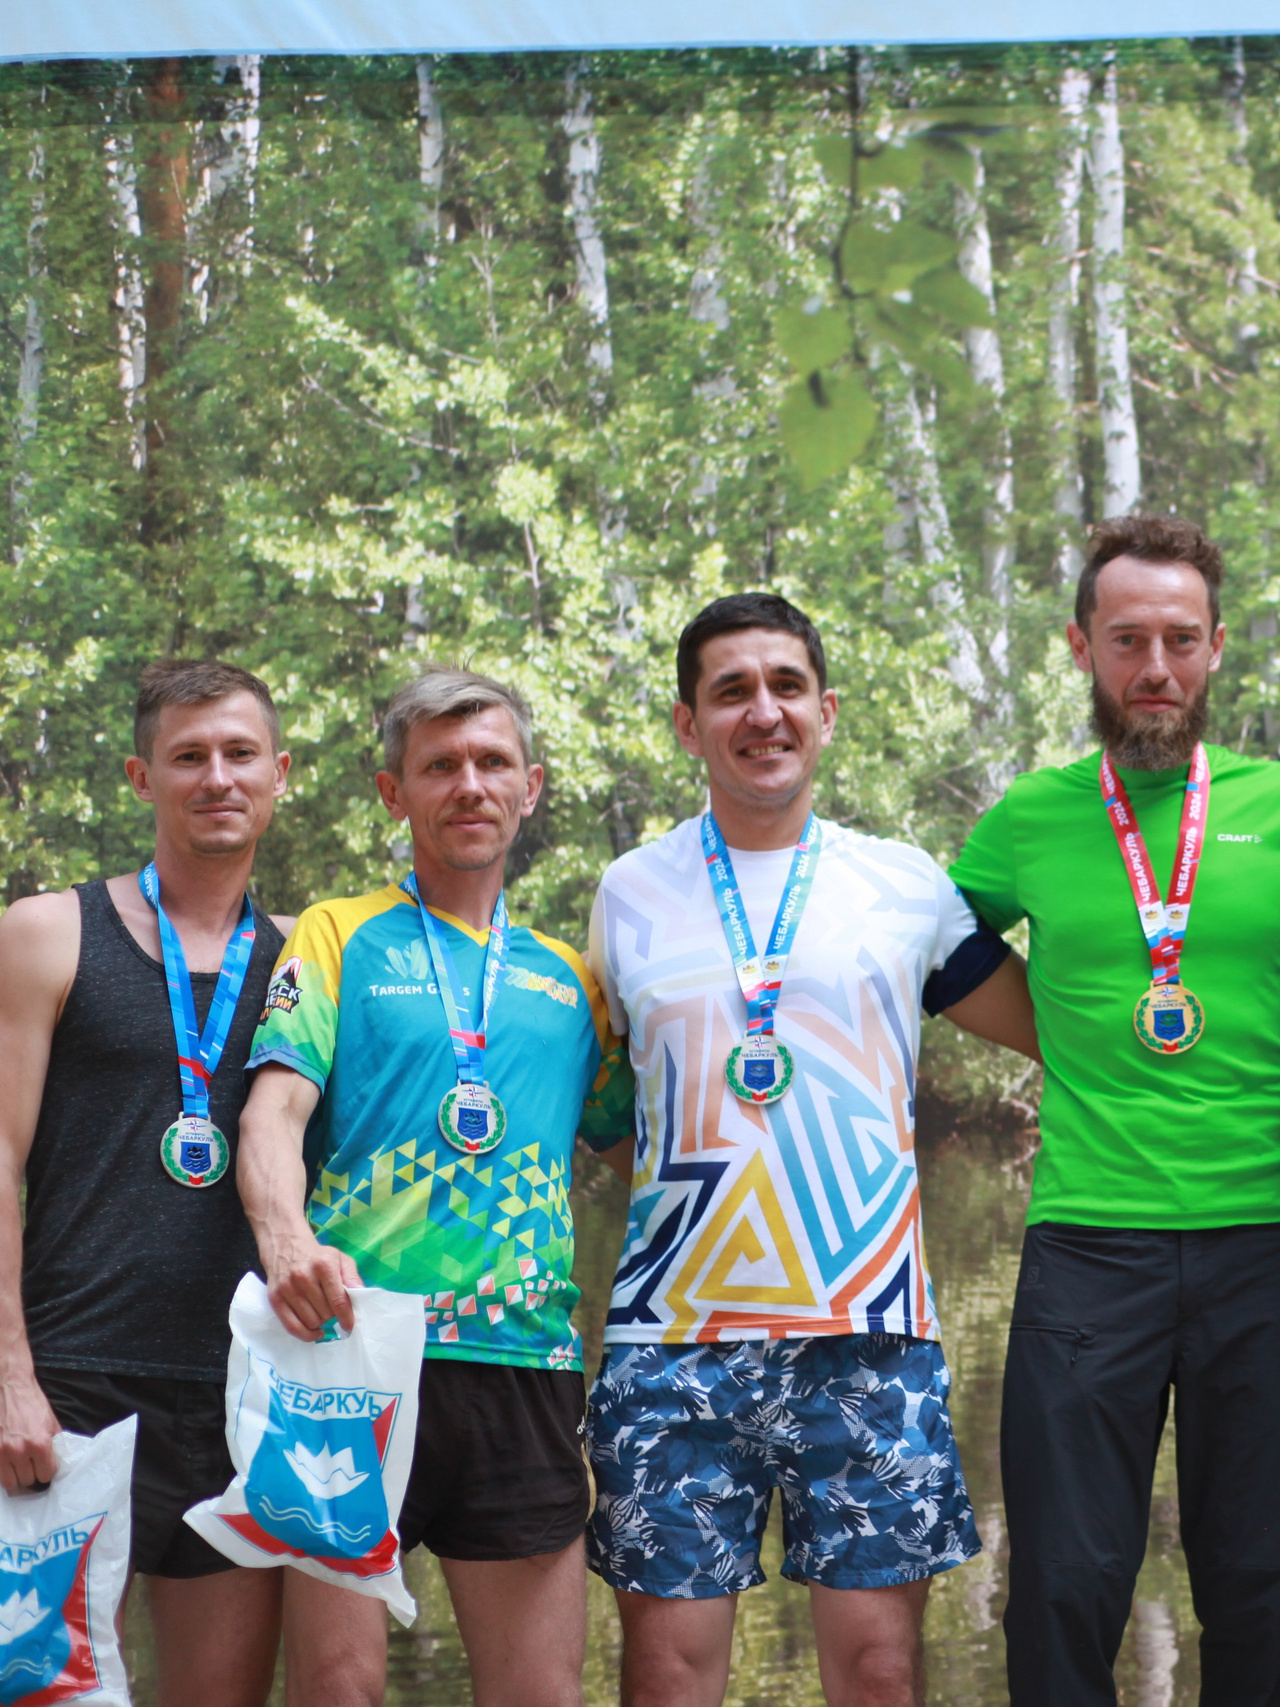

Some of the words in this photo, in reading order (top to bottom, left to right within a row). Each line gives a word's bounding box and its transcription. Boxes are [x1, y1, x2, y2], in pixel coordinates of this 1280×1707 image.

[1114, 801, 1129, 825] 2024
[1217, 833, 1253, 843] CRAFT
[715, 857, 728, 881] 2024
[1125, 832, 1150, 901] ЧЕБАРКУЛЬ
[1176, 826, 1197, 896] ЧЕБАРКУЛЬ
[1189, 793, 1202, 820] 2024
[723, 887, 747, 955] ЧЕБАРКУЛЬ
[773, 884, 802, 950] ЧЕБАРКУЛЬ
[796, 854, 810, 878] 2024
[269, 1368, 383, 1419] ЧЕБАРКУЬ
